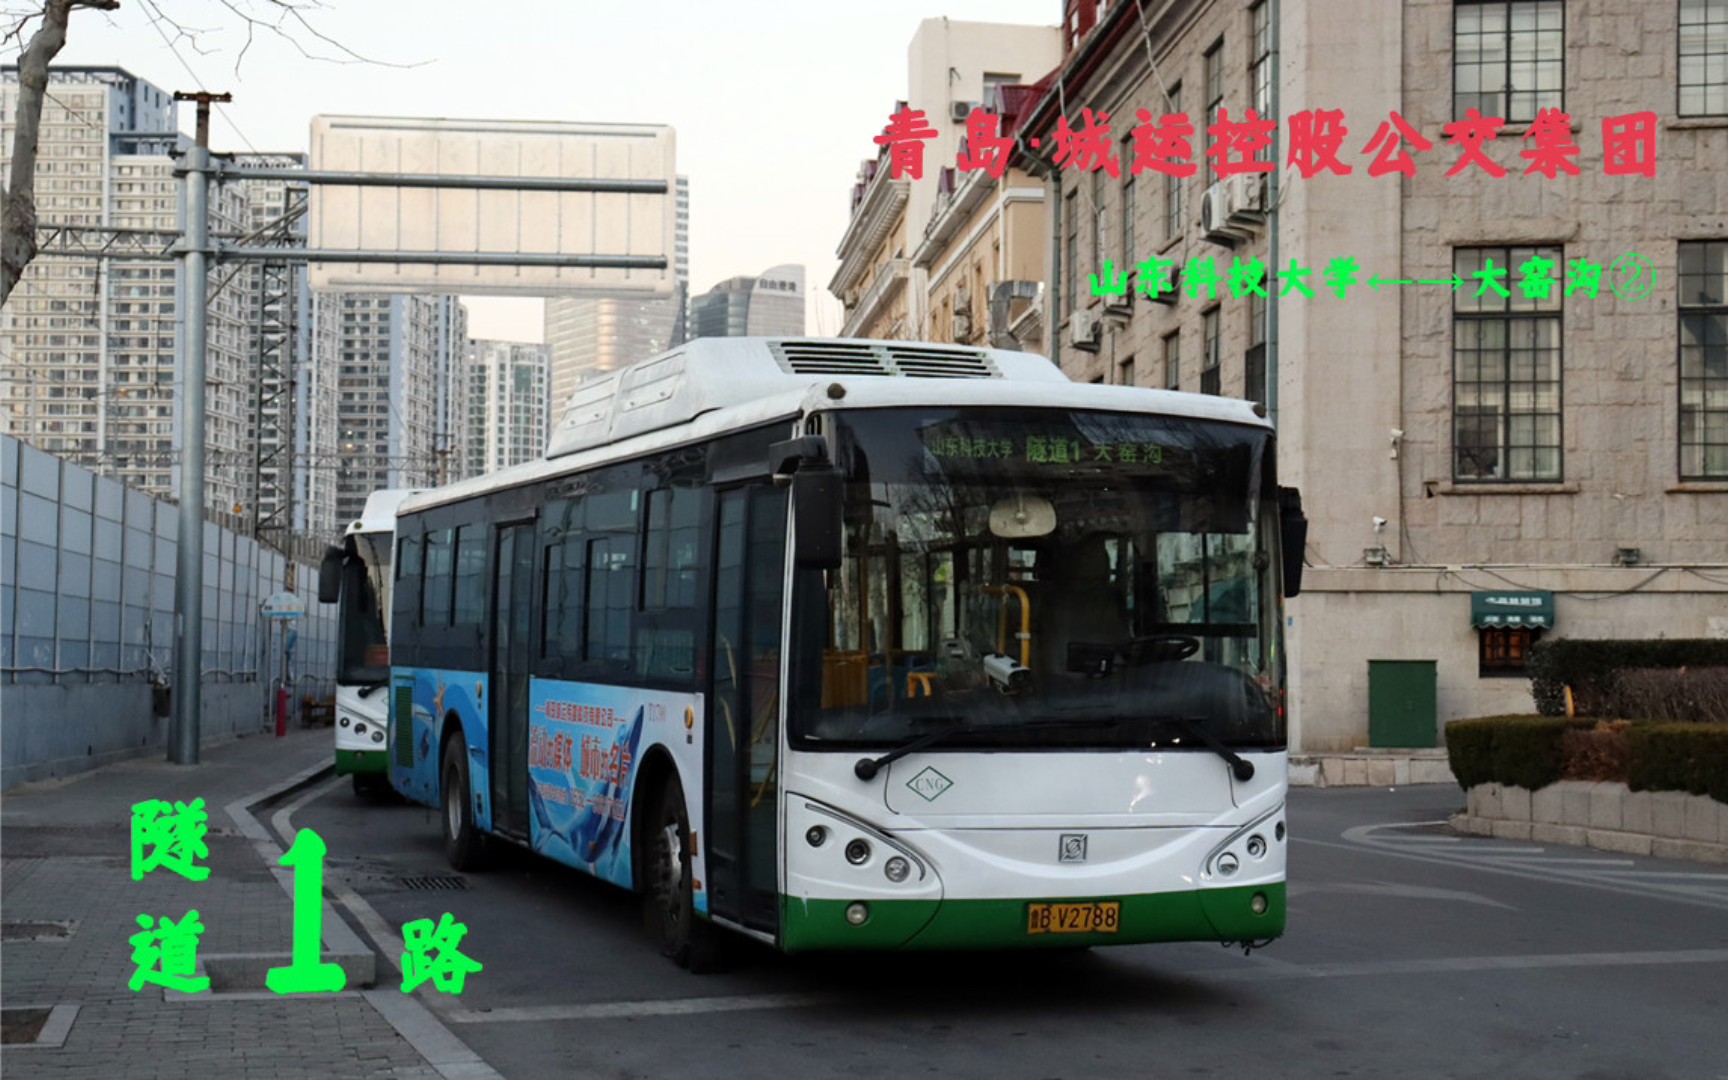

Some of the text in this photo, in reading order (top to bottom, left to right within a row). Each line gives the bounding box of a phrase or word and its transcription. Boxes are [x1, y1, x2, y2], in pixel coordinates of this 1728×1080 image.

[931, 435, 1162, 464] 山东科技大学 隧道1 大窑沟
[915, 778, 943, 790] CNG
